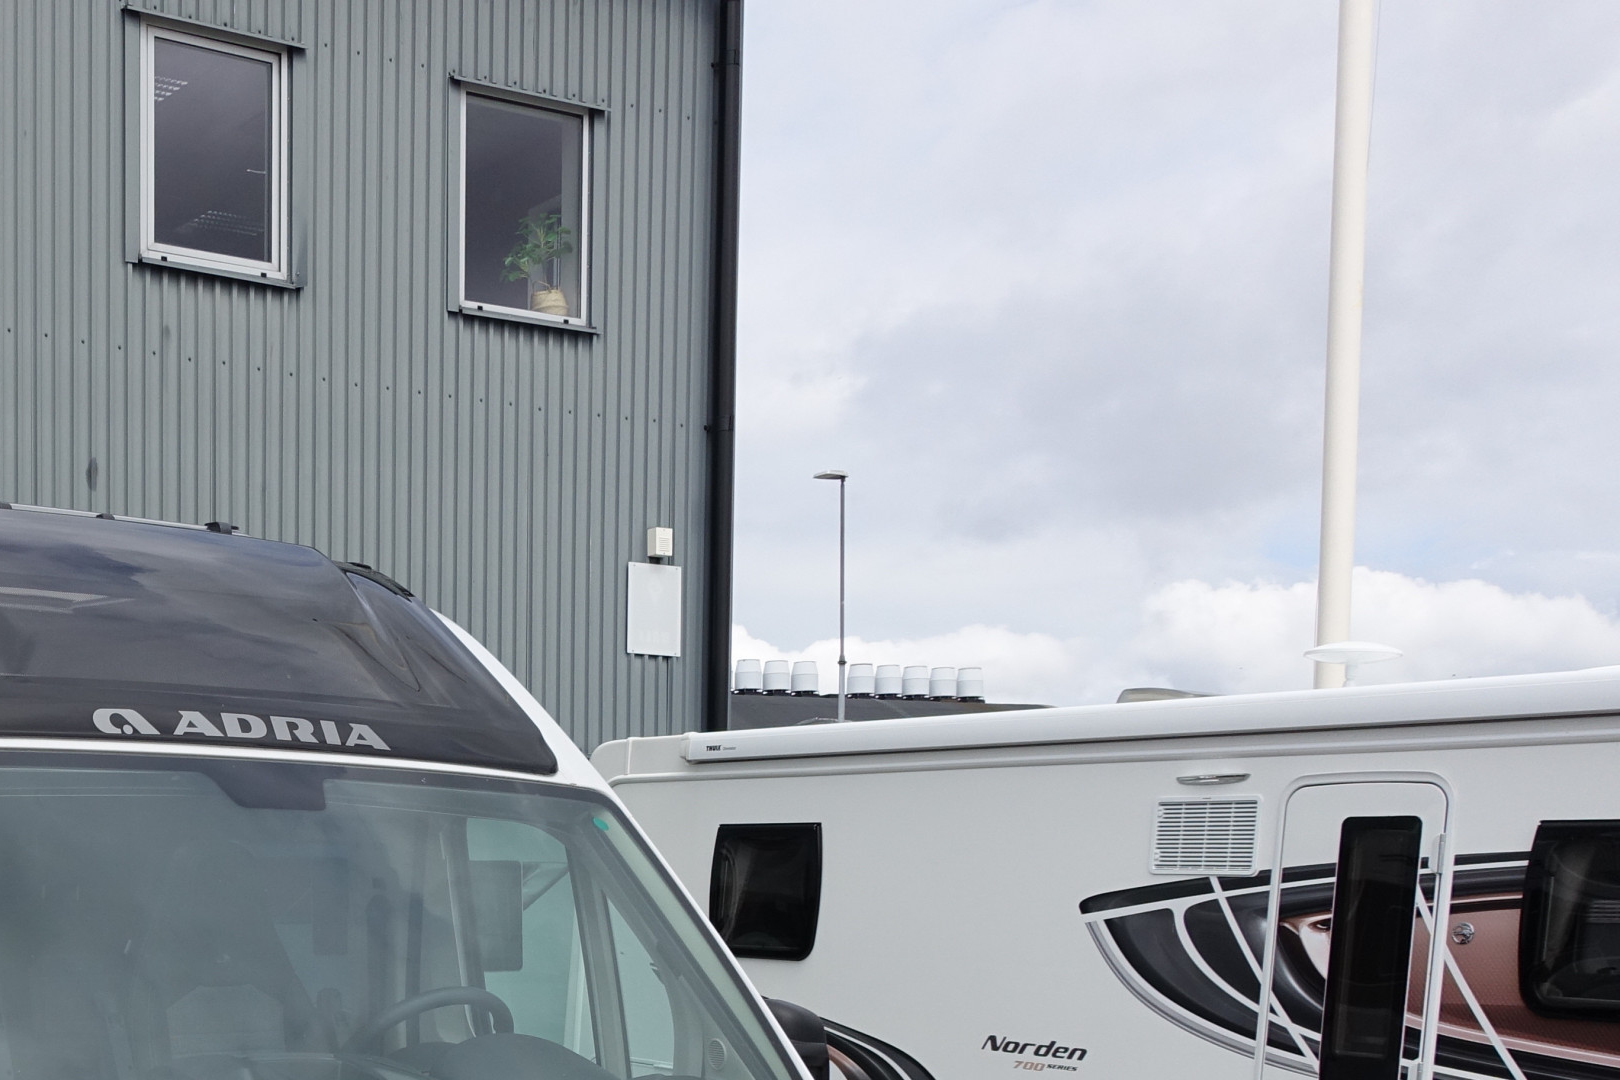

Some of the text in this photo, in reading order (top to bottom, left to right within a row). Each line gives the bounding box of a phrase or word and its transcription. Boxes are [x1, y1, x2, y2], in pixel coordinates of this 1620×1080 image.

[173, 710, 392, 751] ADRIA
[981, 1035, 1088, 1061] Norden
[1013, 1061, 1078, 1072] 700 SERIES
